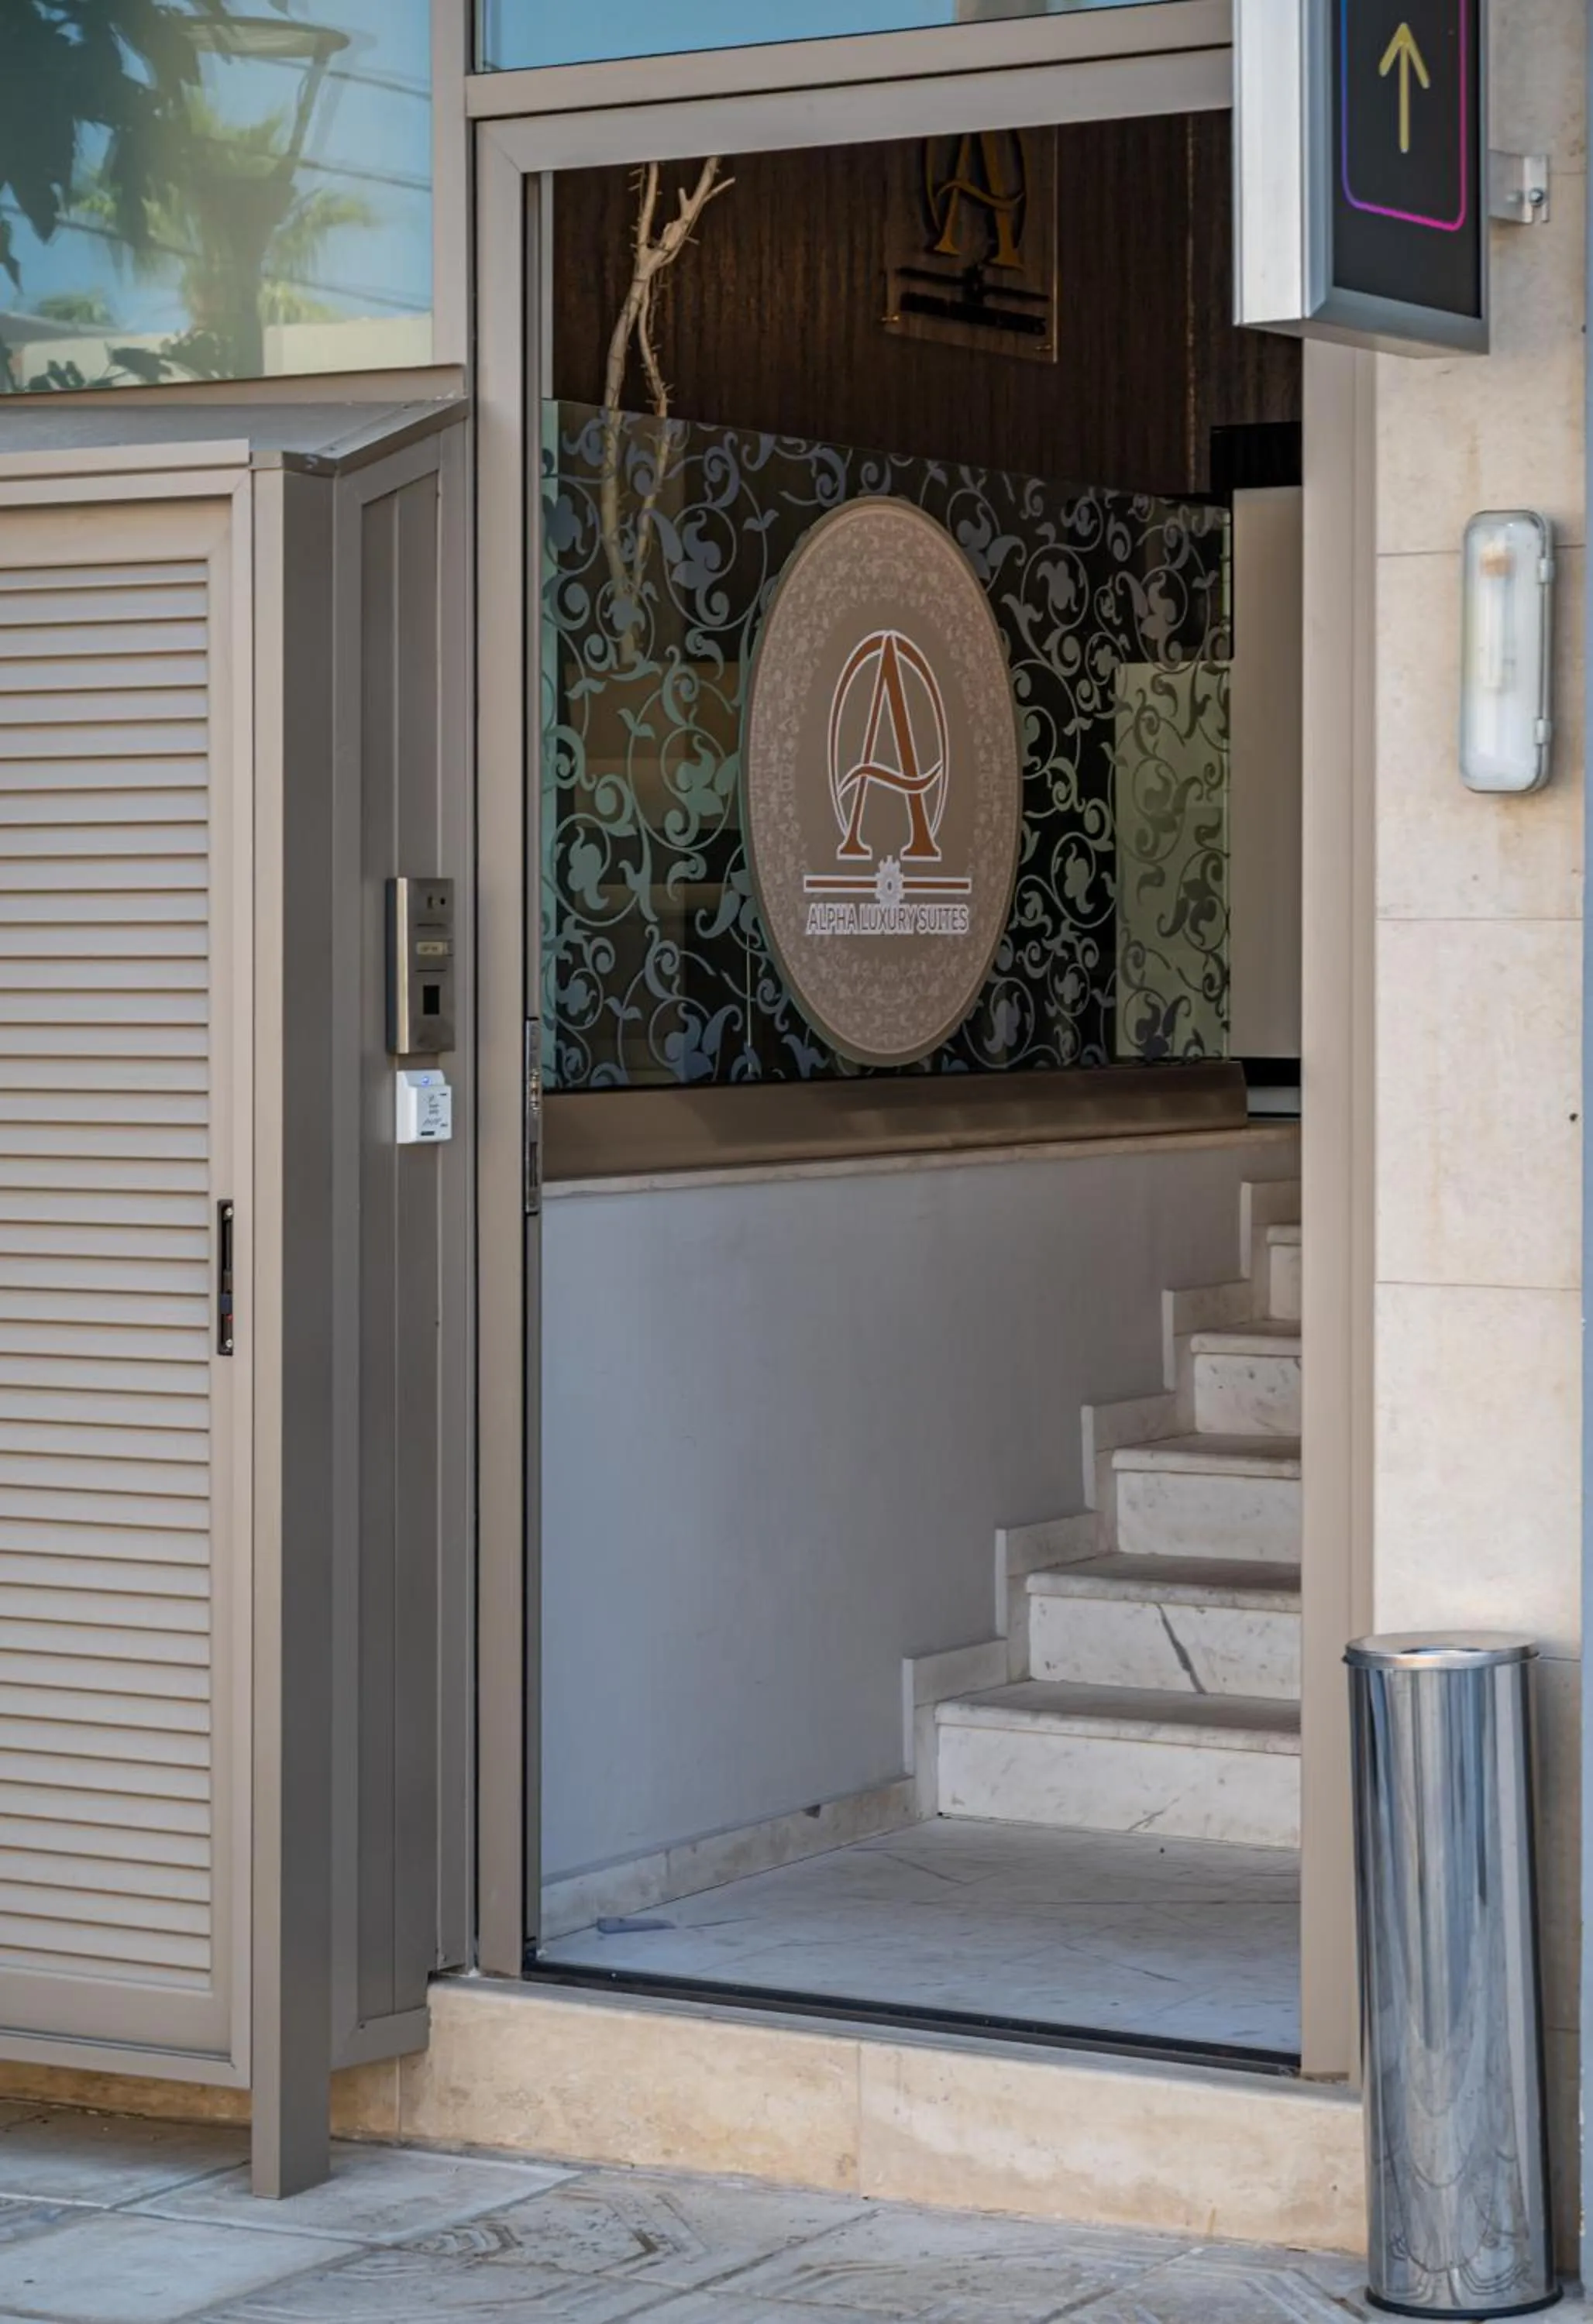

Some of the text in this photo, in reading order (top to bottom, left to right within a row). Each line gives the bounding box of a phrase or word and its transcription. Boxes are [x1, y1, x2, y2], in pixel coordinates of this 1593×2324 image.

[807, 905, 969, 933] ALPHA LUXURY SUITES
